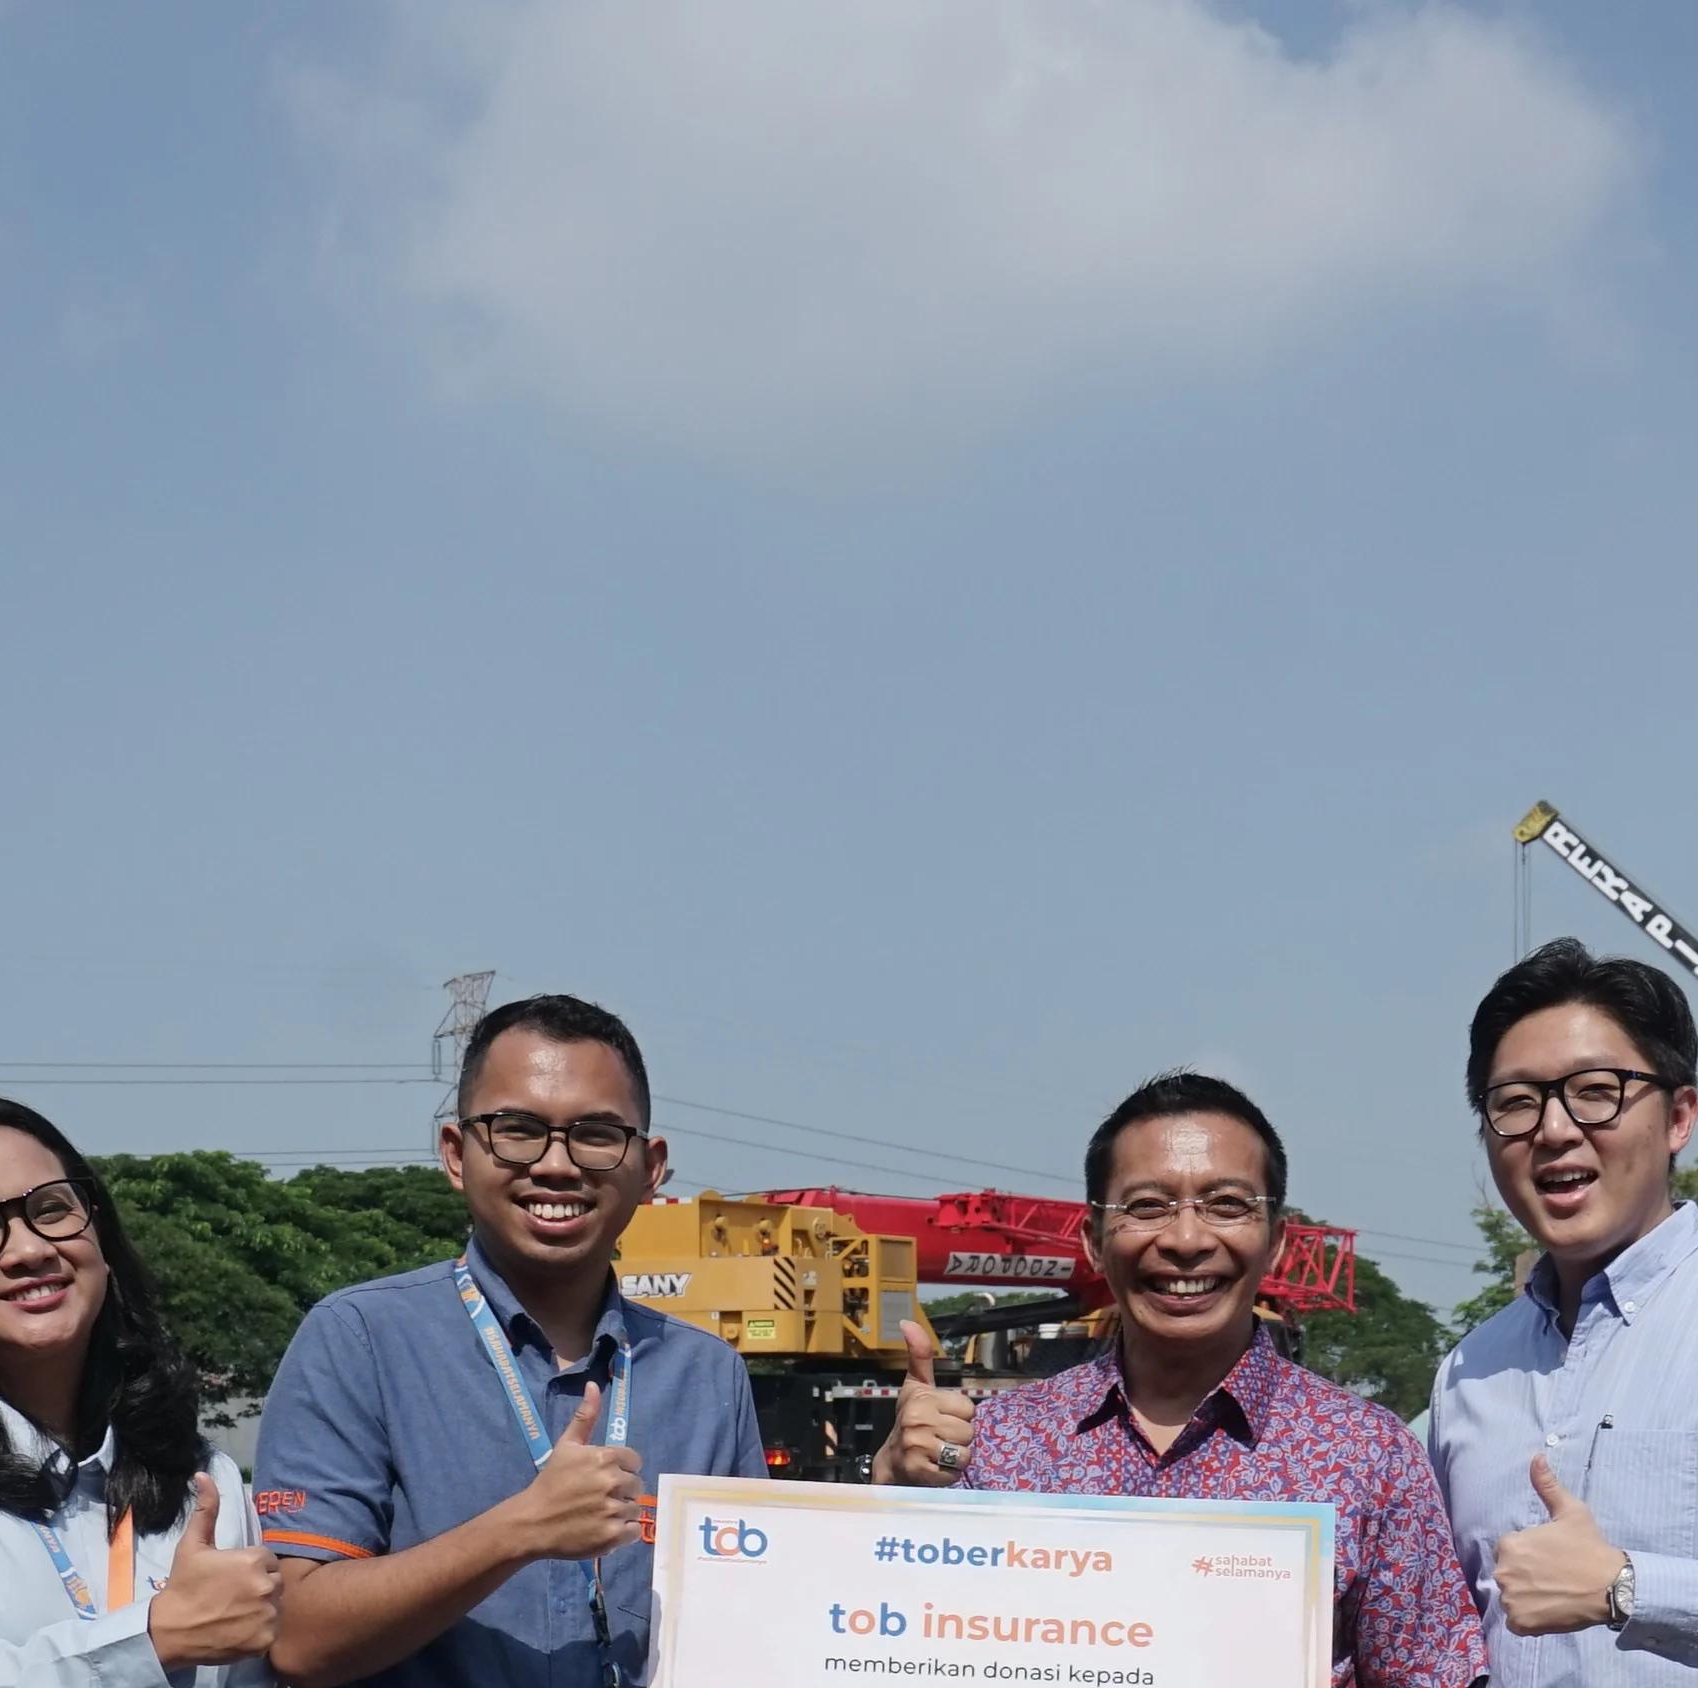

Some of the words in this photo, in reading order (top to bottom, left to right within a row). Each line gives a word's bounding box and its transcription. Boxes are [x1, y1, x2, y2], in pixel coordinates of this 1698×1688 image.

[1542, 821, 1653, 923] REKA
[948, 1254, 1072, 1277] INDOPORA
[621, 1273, 691, 1298] SANY
[255, 1489, 307, 1514] EREN
[699, 1517, 767, 1557] tob
[875, 1537, 1111, 1577] #toberkarya
[1215, 1554, 1273, 1567] sahabat
[1215, 1566, 1291, 1581] selamanya
[829, 1602, 906, 1636] tob
[924, 1602, 1153, 1647] insurance
[825, 1657, 974, 1677] memberikan
[984, 1662, 1060, 1681] donasi
[1070, 1665, 1153, 1687] kepada
